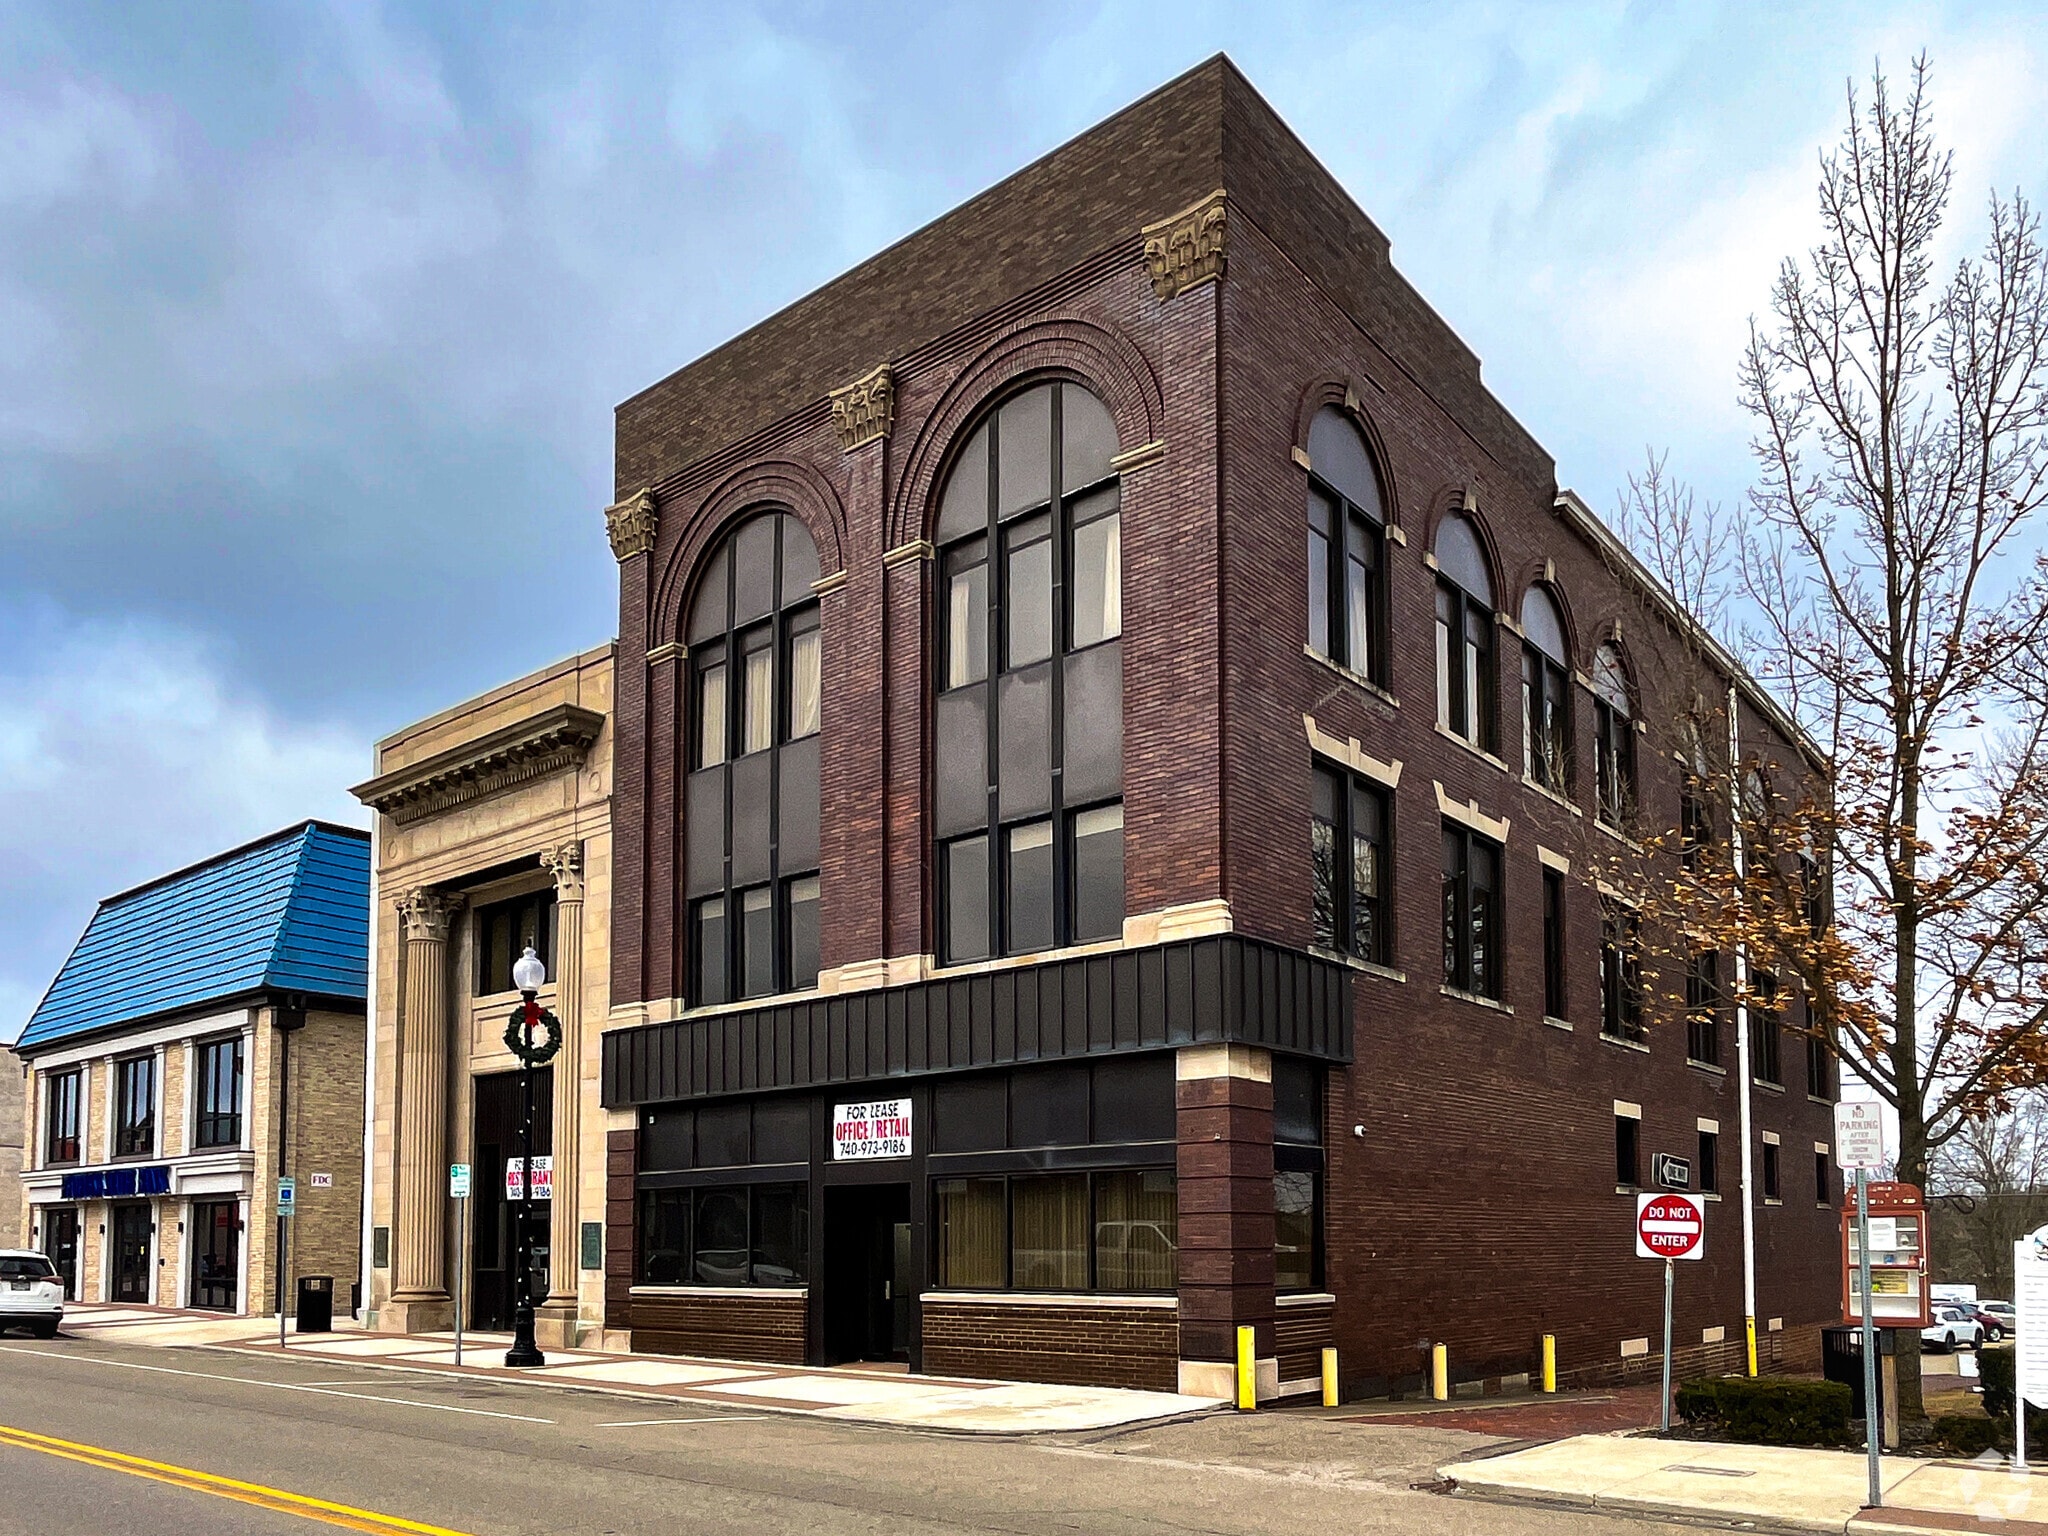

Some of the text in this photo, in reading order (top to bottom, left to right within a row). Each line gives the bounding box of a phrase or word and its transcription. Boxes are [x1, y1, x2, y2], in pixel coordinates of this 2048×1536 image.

[847, 1102, 899, 1120] FOR LEASE
[1852, 1108, 1865, 1118] NO
[1840, 1120, 1878, 1130] PARKING
[840, 1138, 906, 1157] 740-973-9186
[313, 1175, 331, 1184] FDC
[508, 1170, 553, 1186] RESTRANT
[1649, 1206, 1692, 1219] DO NOT
[1651, 1234, 1688, 1247] ENTER
